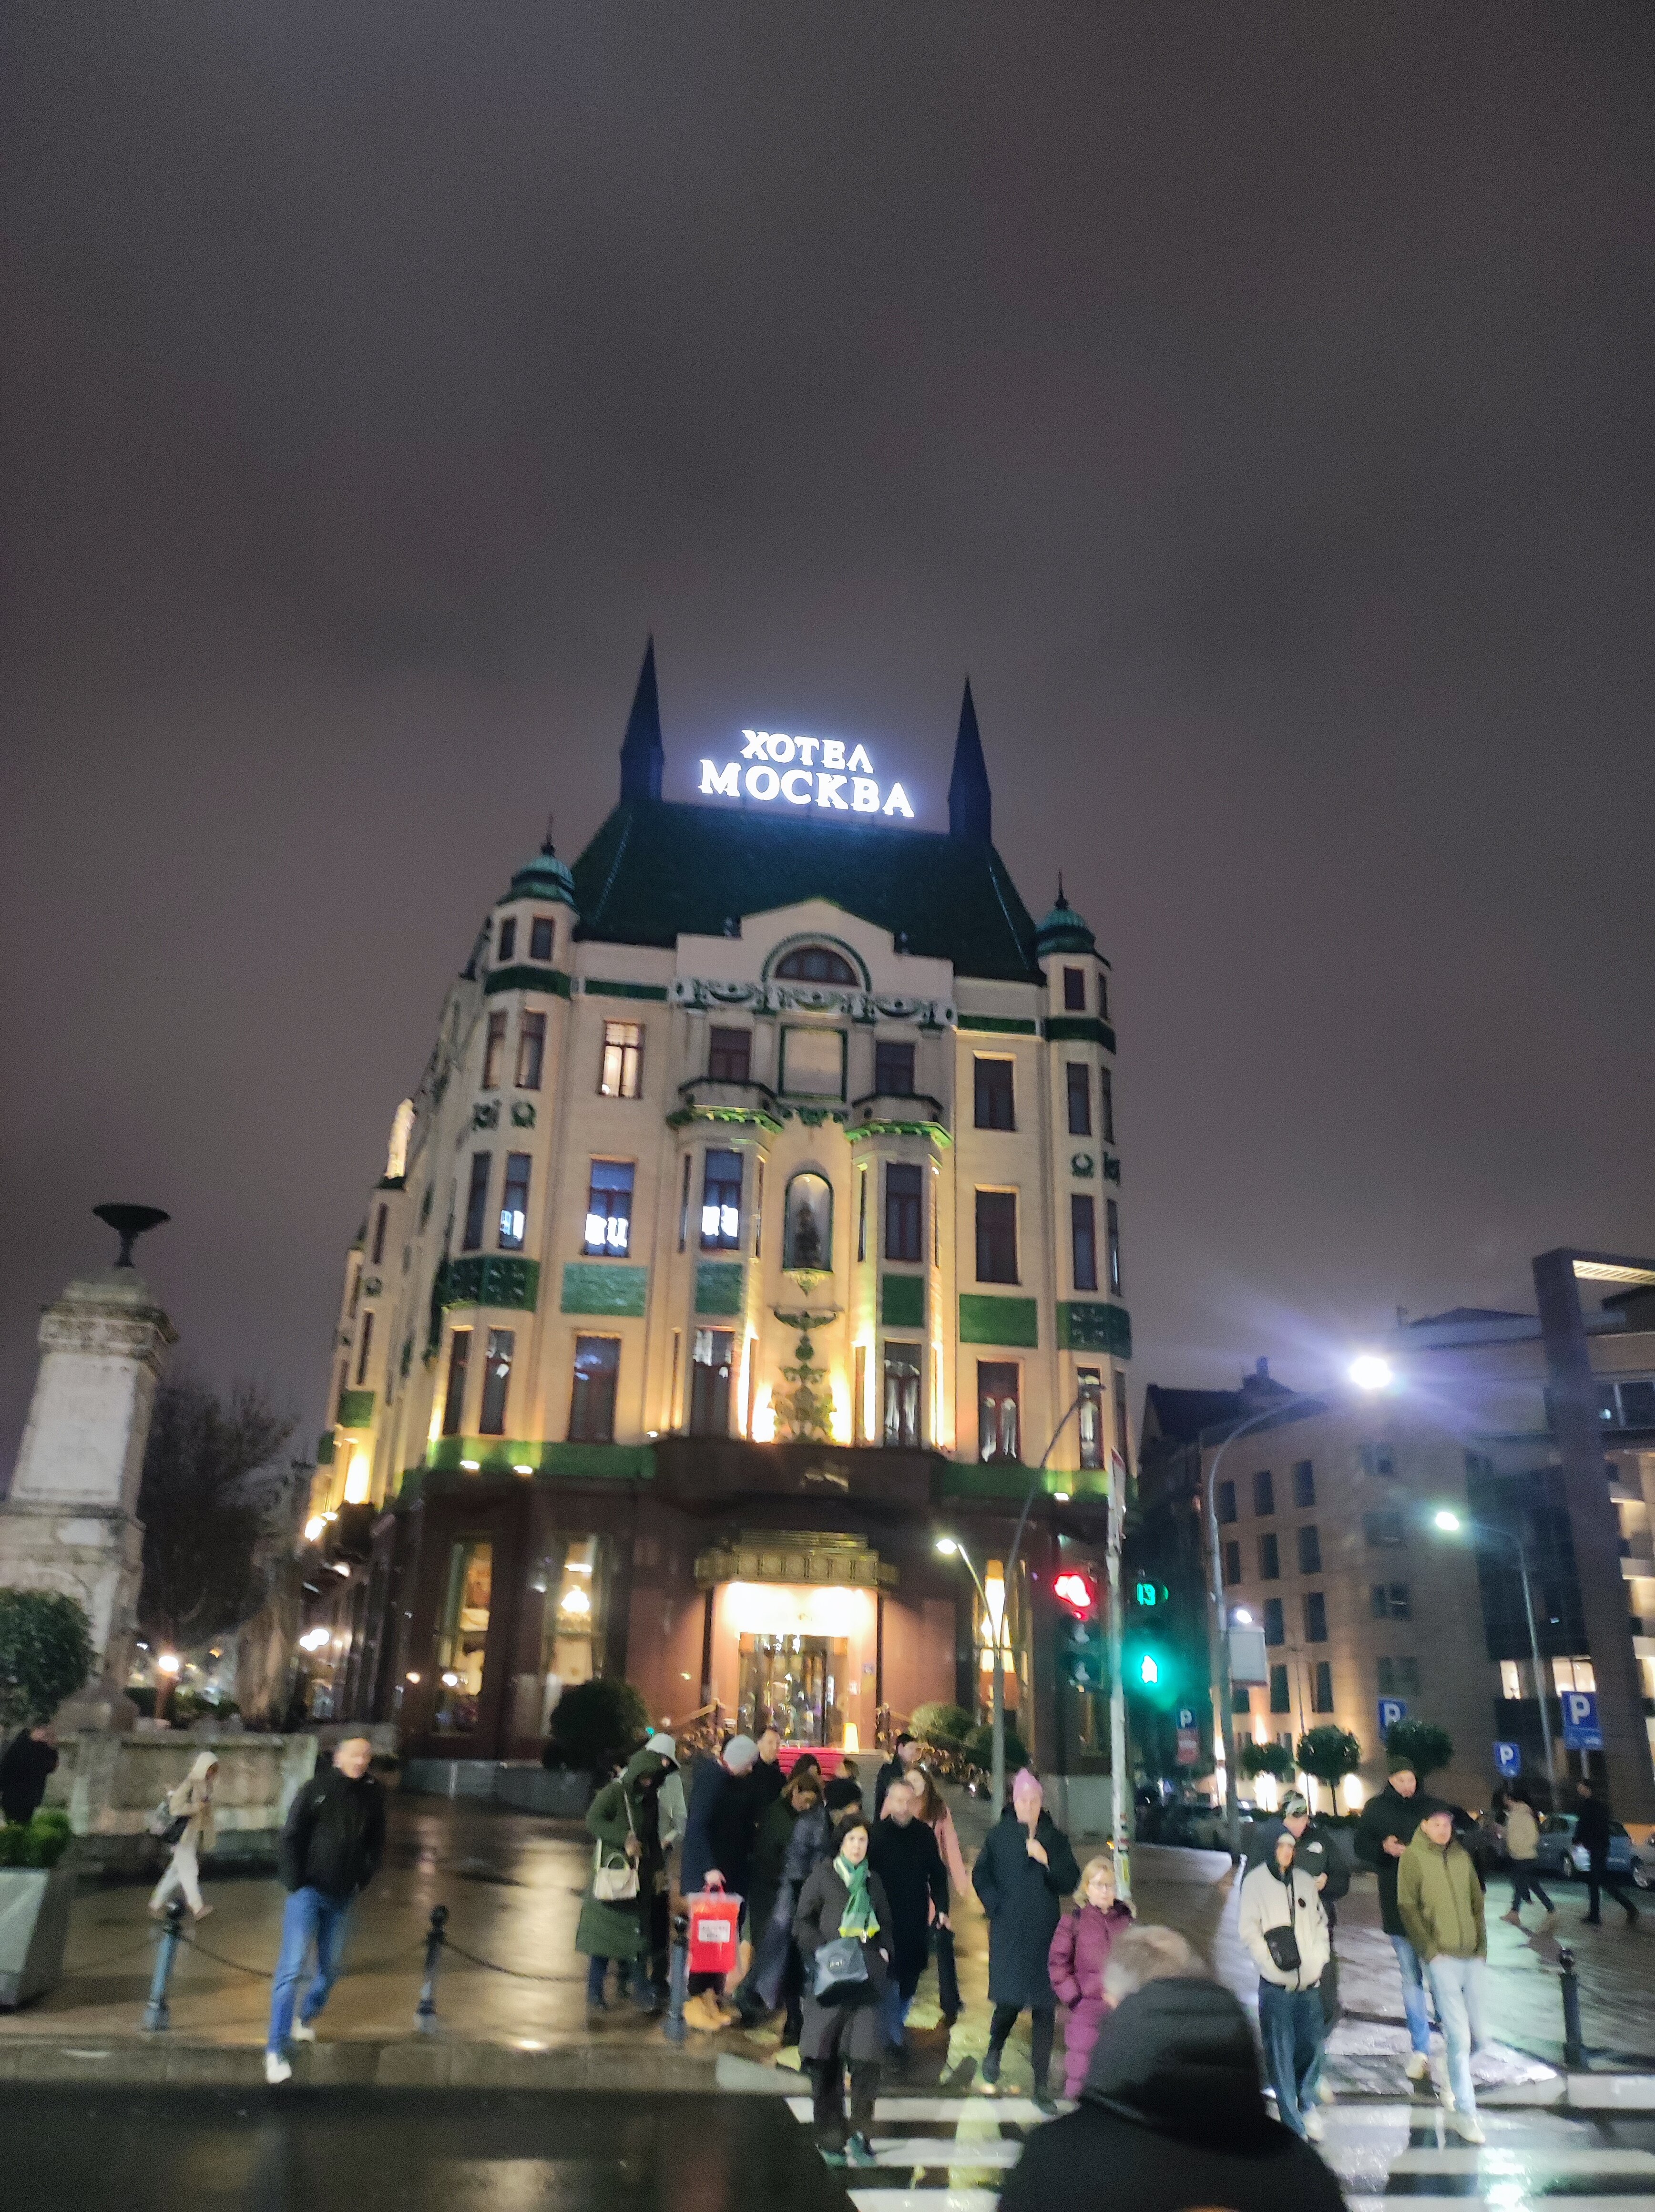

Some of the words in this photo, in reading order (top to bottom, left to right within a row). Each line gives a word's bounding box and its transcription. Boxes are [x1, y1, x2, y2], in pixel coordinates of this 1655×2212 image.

[698, 759, 914, 818] МОСКВА
[1180, 1710, 1192, 1728] P
[1384, 1703, 1400, 1726] P
[1570, 1694, 1590, 1725] P
[1499, 1745, 1513, 1764] P
